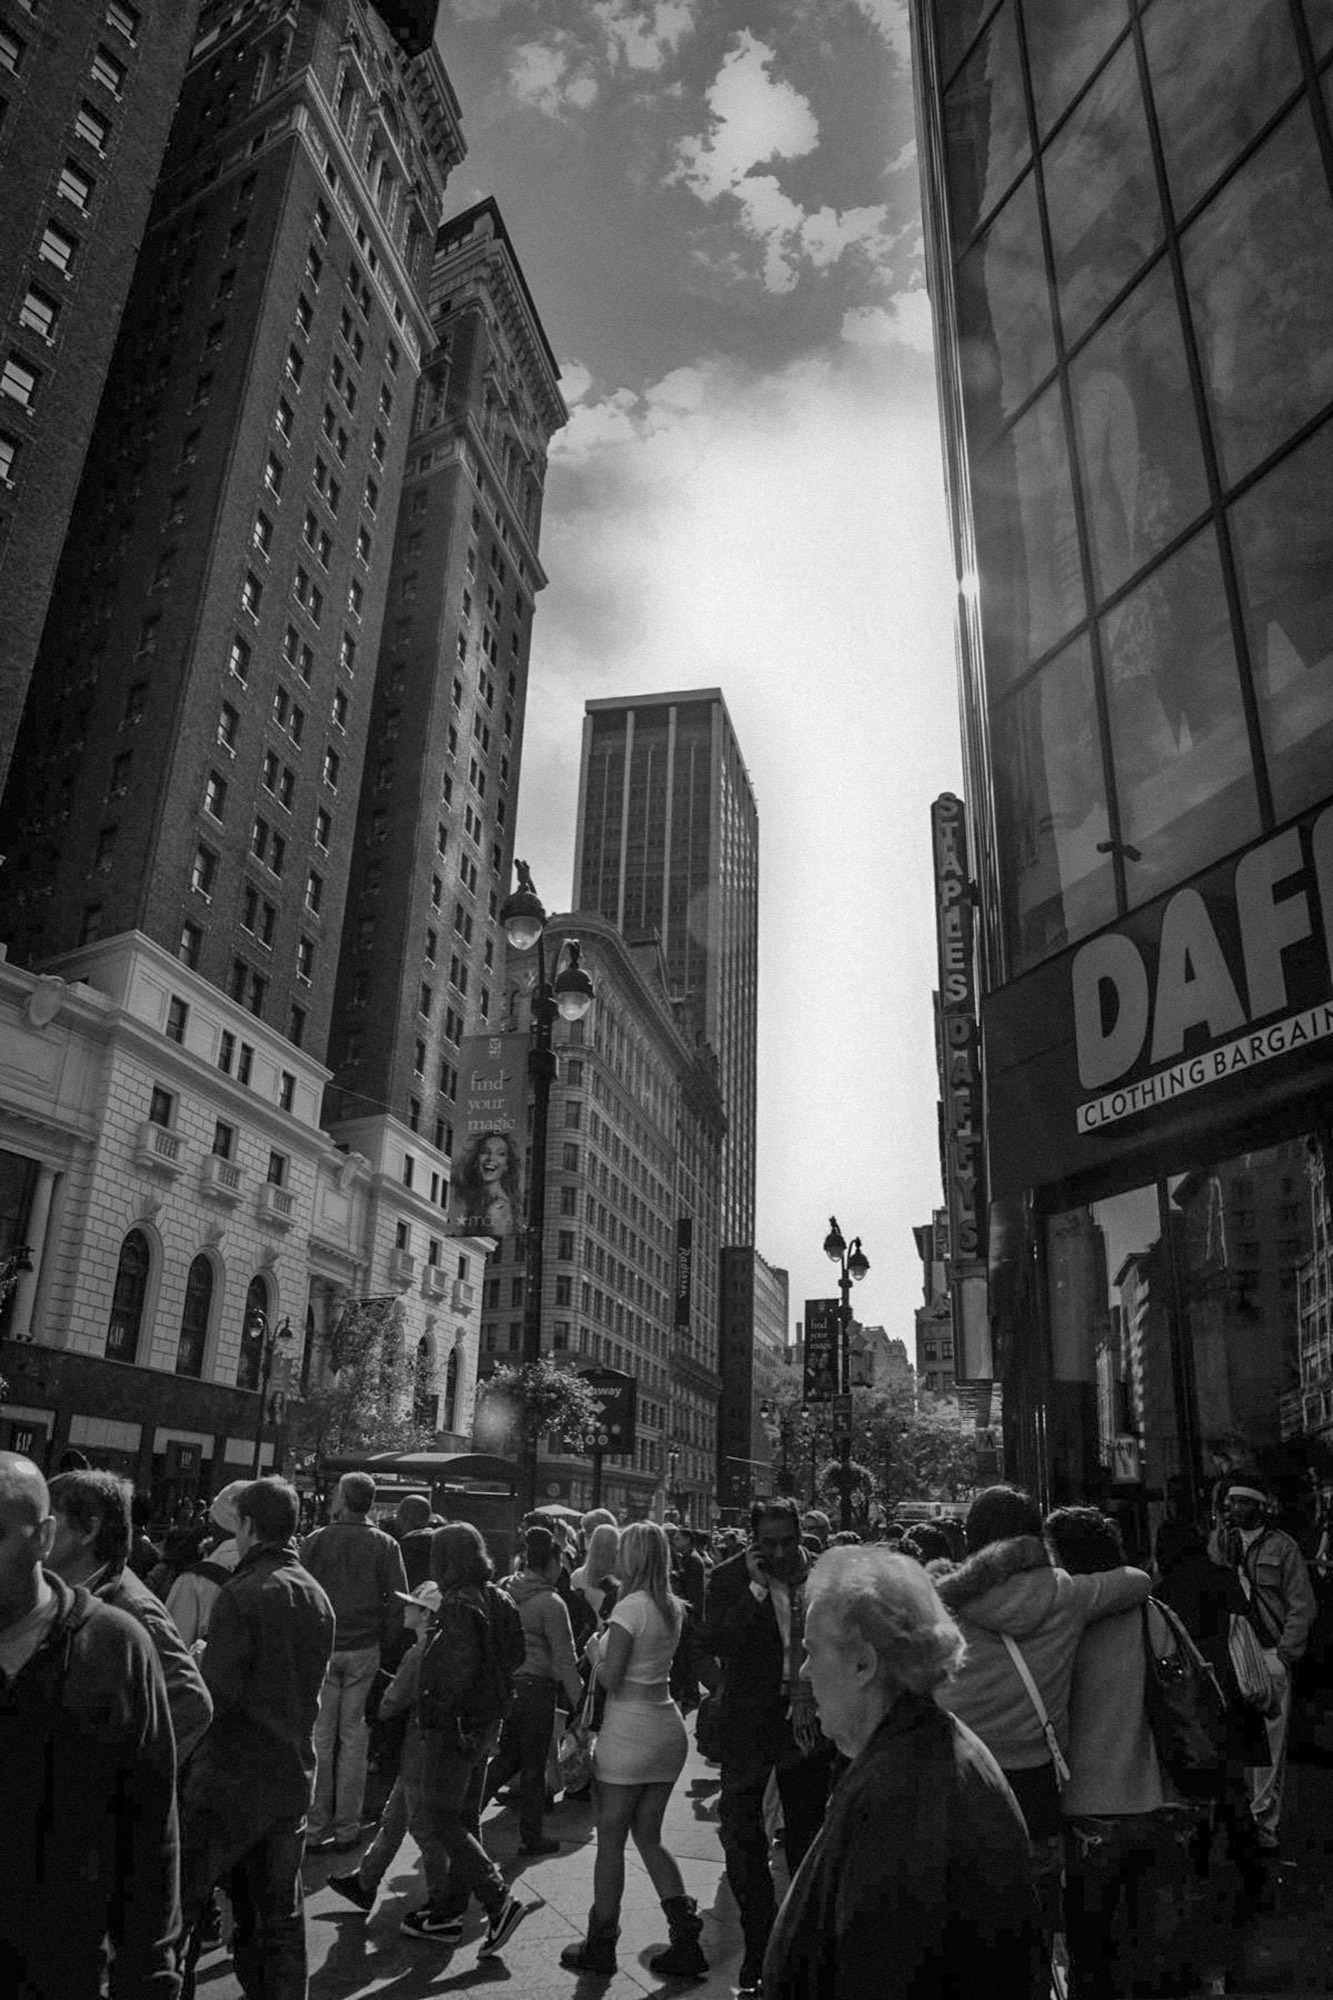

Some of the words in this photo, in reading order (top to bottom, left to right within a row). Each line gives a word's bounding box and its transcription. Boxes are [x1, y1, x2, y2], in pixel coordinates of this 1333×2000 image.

[938, 792, 969, 1003] STAPLES
[1071, 803, 1333, 1091] DAF
[471, 1069, 504, 1091] find
[1084, 1060, 1206, 1128] CLOTHING
[466, 1098, 506, 1115] your
[467, 1112, 517, 1135] magic
